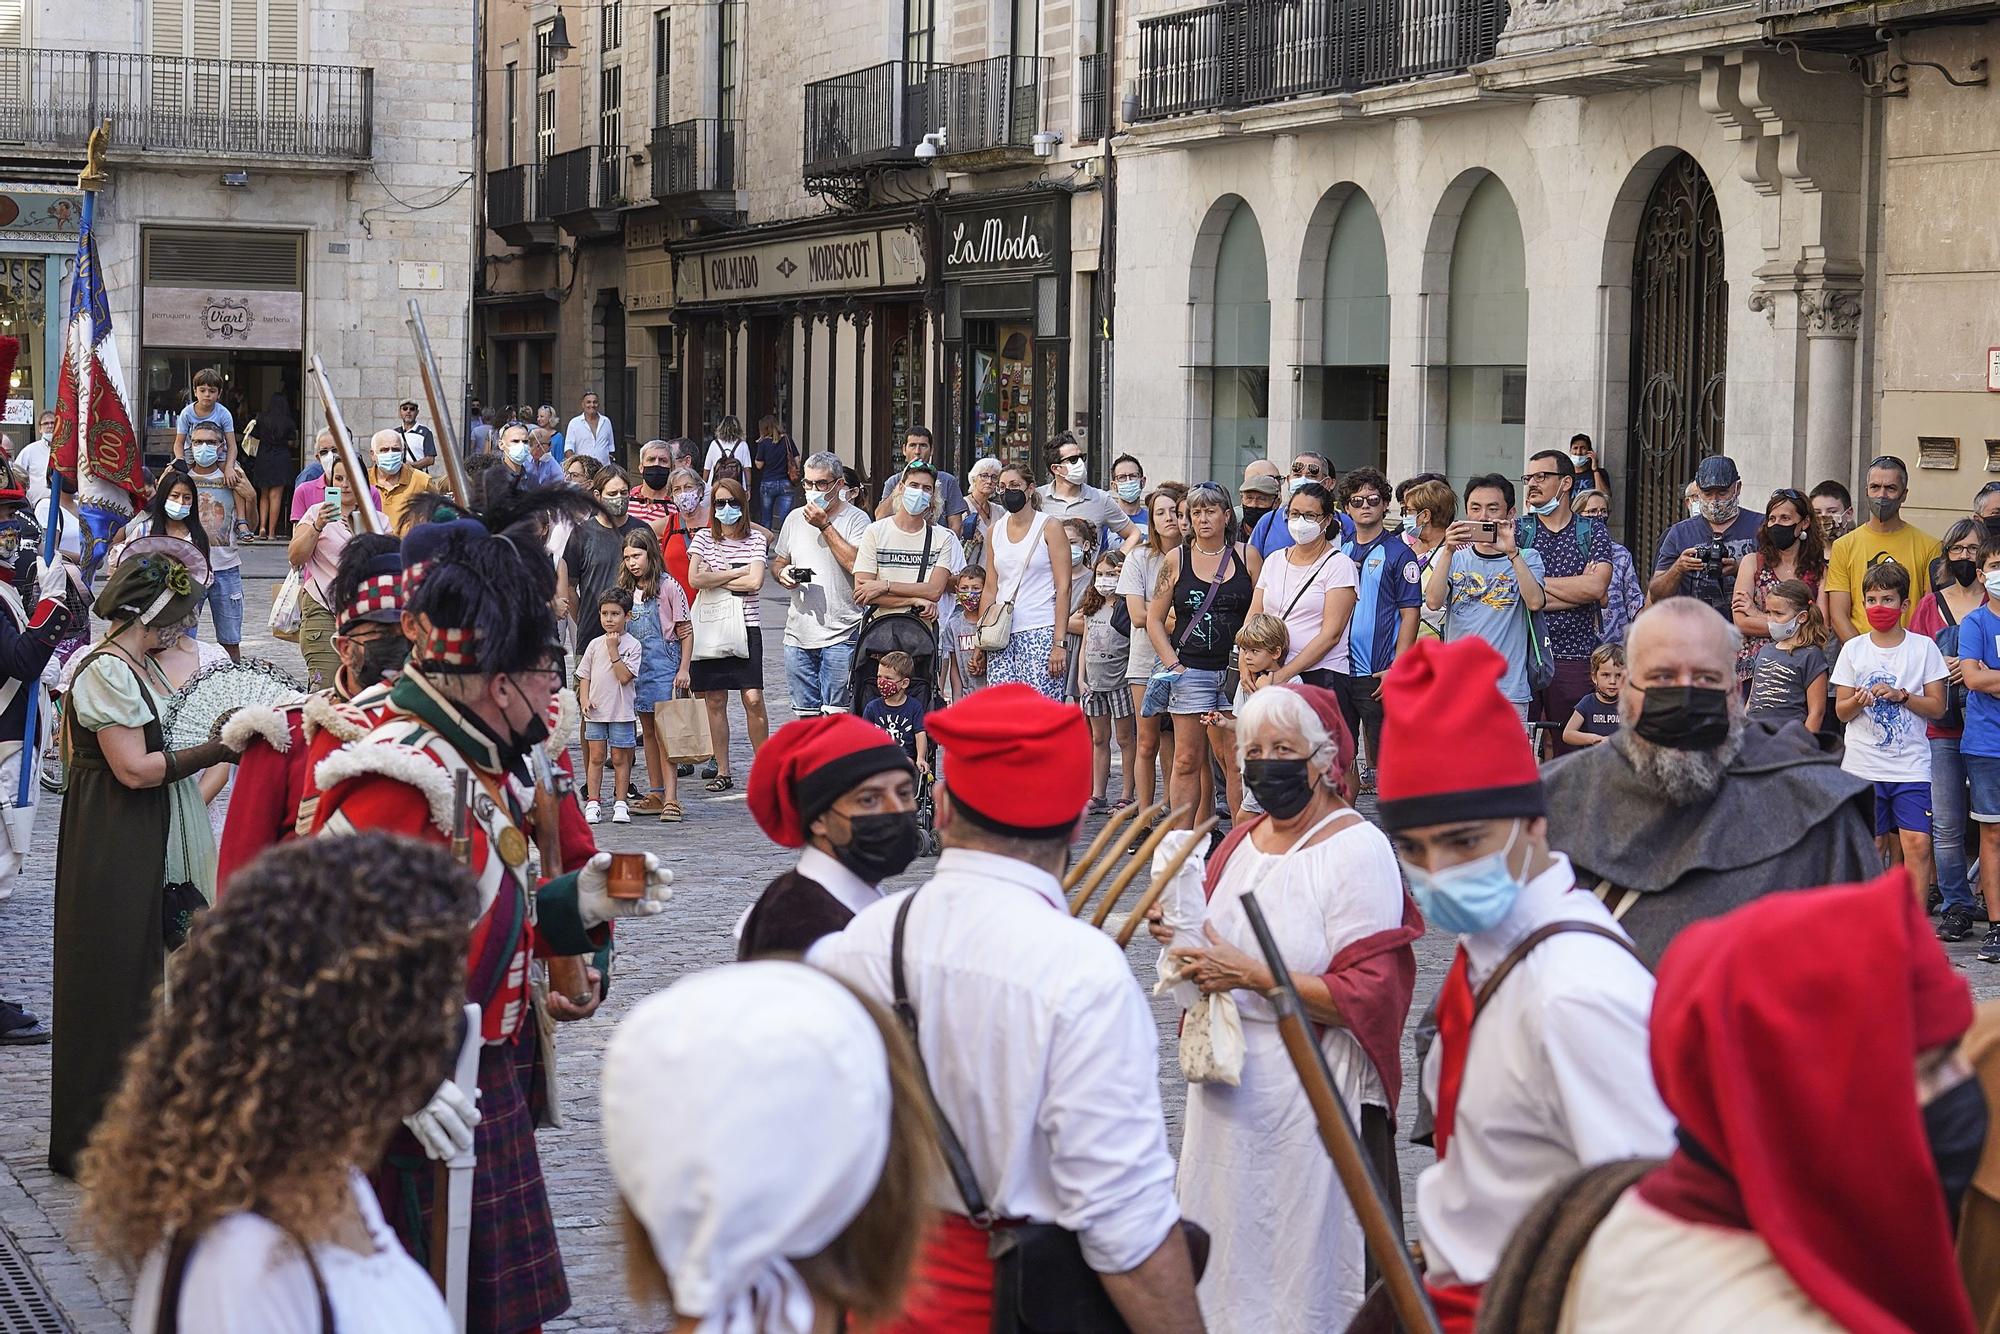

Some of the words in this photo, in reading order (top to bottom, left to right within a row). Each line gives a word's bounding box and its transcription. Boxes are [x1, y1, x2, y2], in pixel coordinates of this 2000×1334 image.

[979, 215, 1043, 262] Moda
[712, 255, 758, 291] COLMADO
[807, 239, 871, 282] MORISCOT
[210, 310, 244, 323] Viart
[890, 554, 923, 564] JACK&JON
[1592, 713, 1606, 724] GIRL
